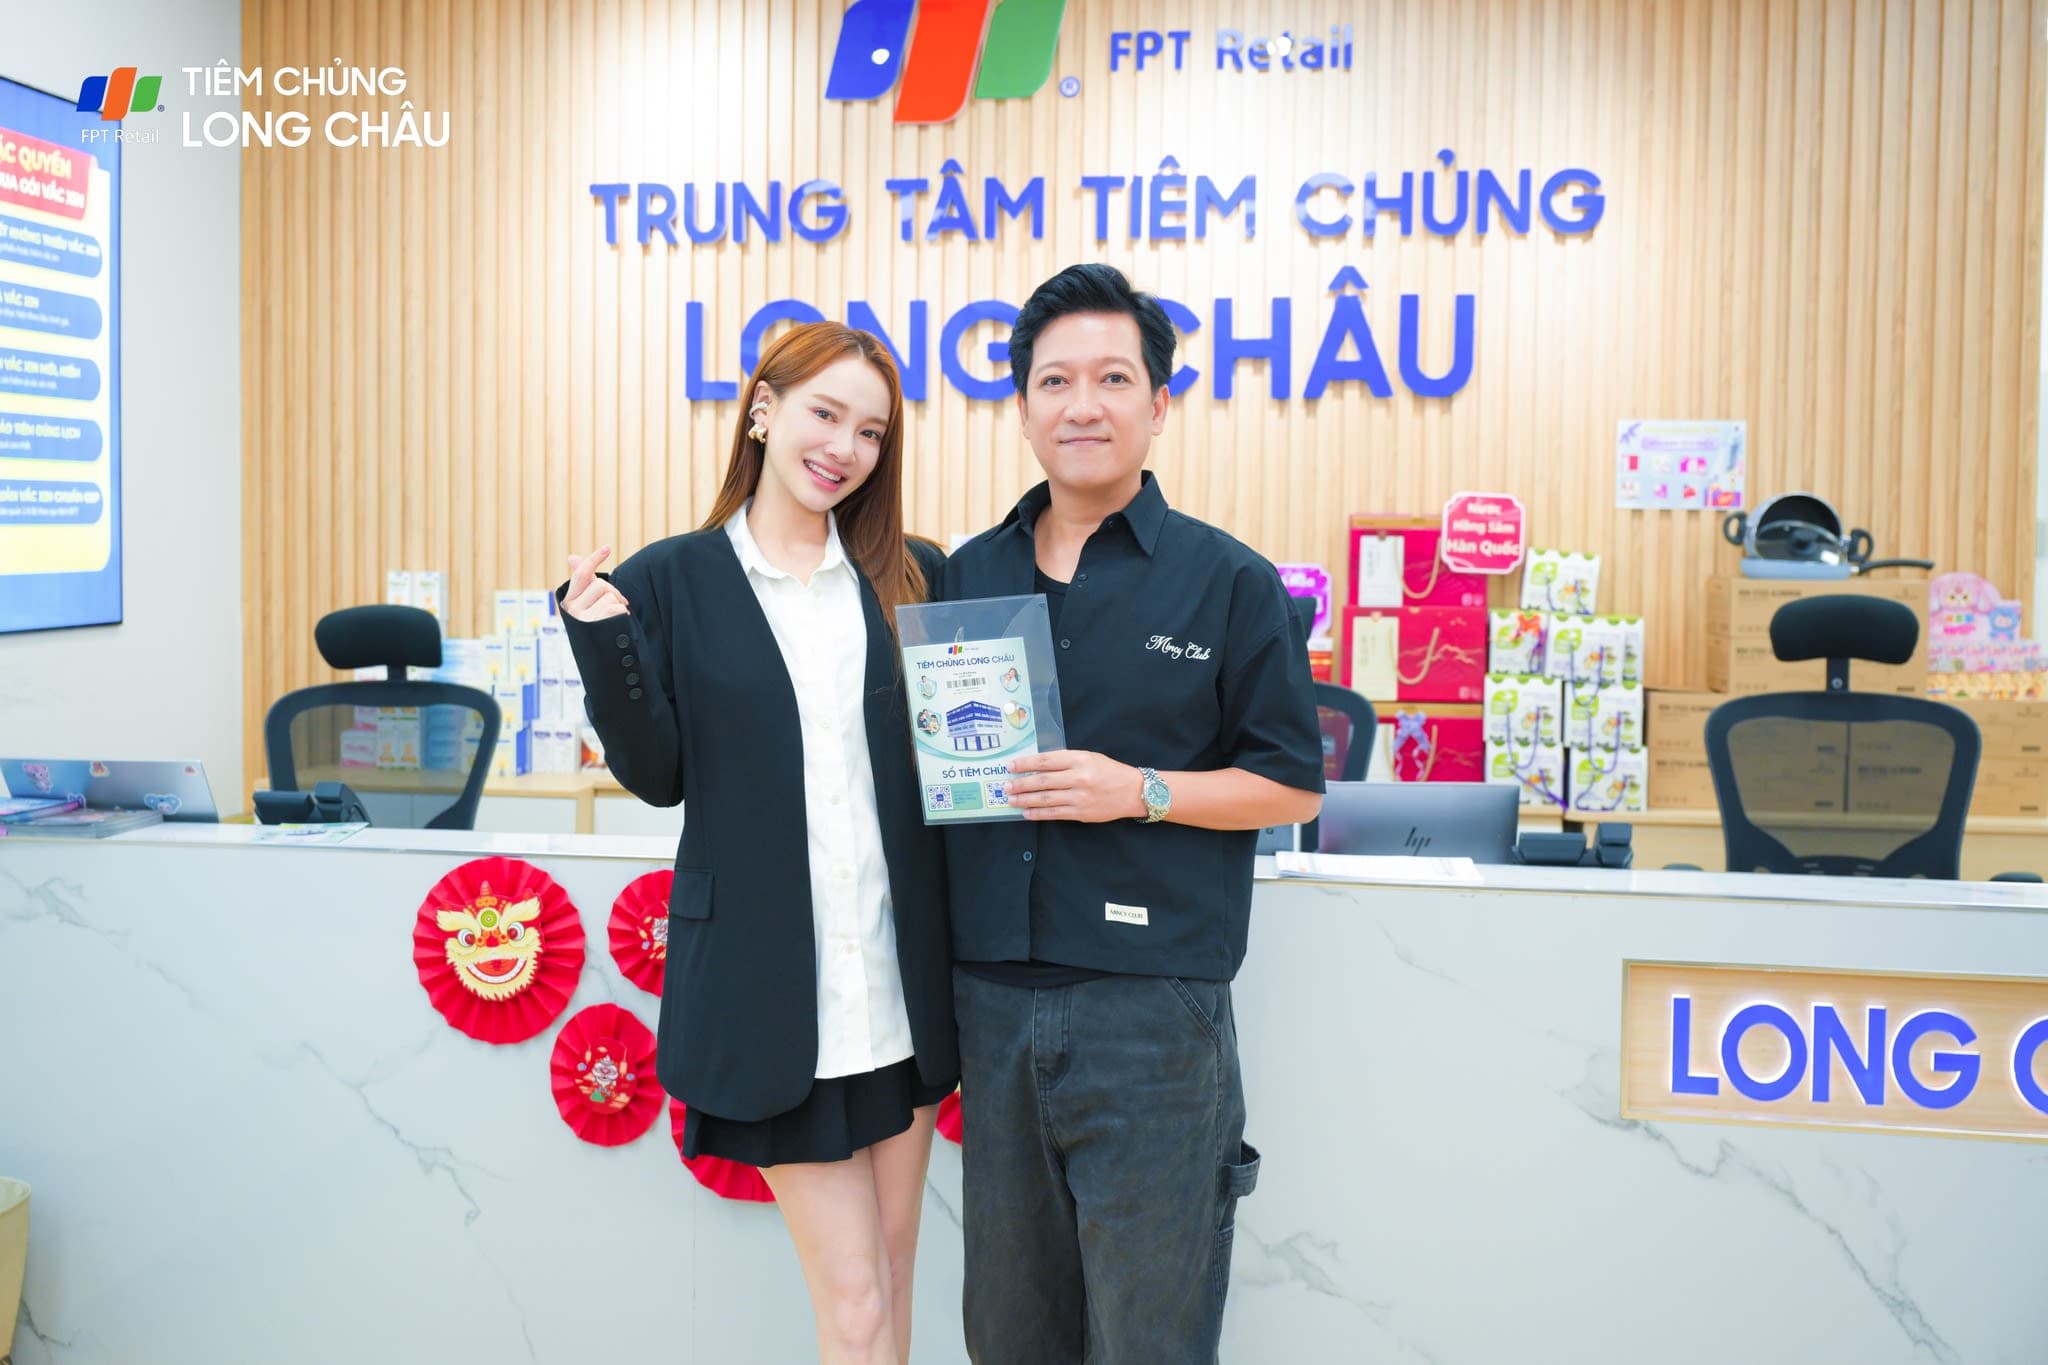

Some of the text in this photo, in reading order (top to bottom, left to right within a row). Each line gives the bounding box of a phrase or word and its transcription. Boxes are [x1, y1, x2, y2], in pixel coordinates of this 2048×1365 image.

[1110, 25, 1353, 72] FPT Retail
[590, 148, 1606, 245] TRUNG TÂM TIÊM CHỦNG
[686, 299, 1020, 401] LONG
[916, 652, 1015, 670] TIÊM CHỦNG LONG CHÂU
[1185, 641, 1211, 660] Club
[959, 765, 981, 777] TIÊM
[983, 763, 1010, 776] CHỦN
[1671, 994, 1981, 1110] LONG
